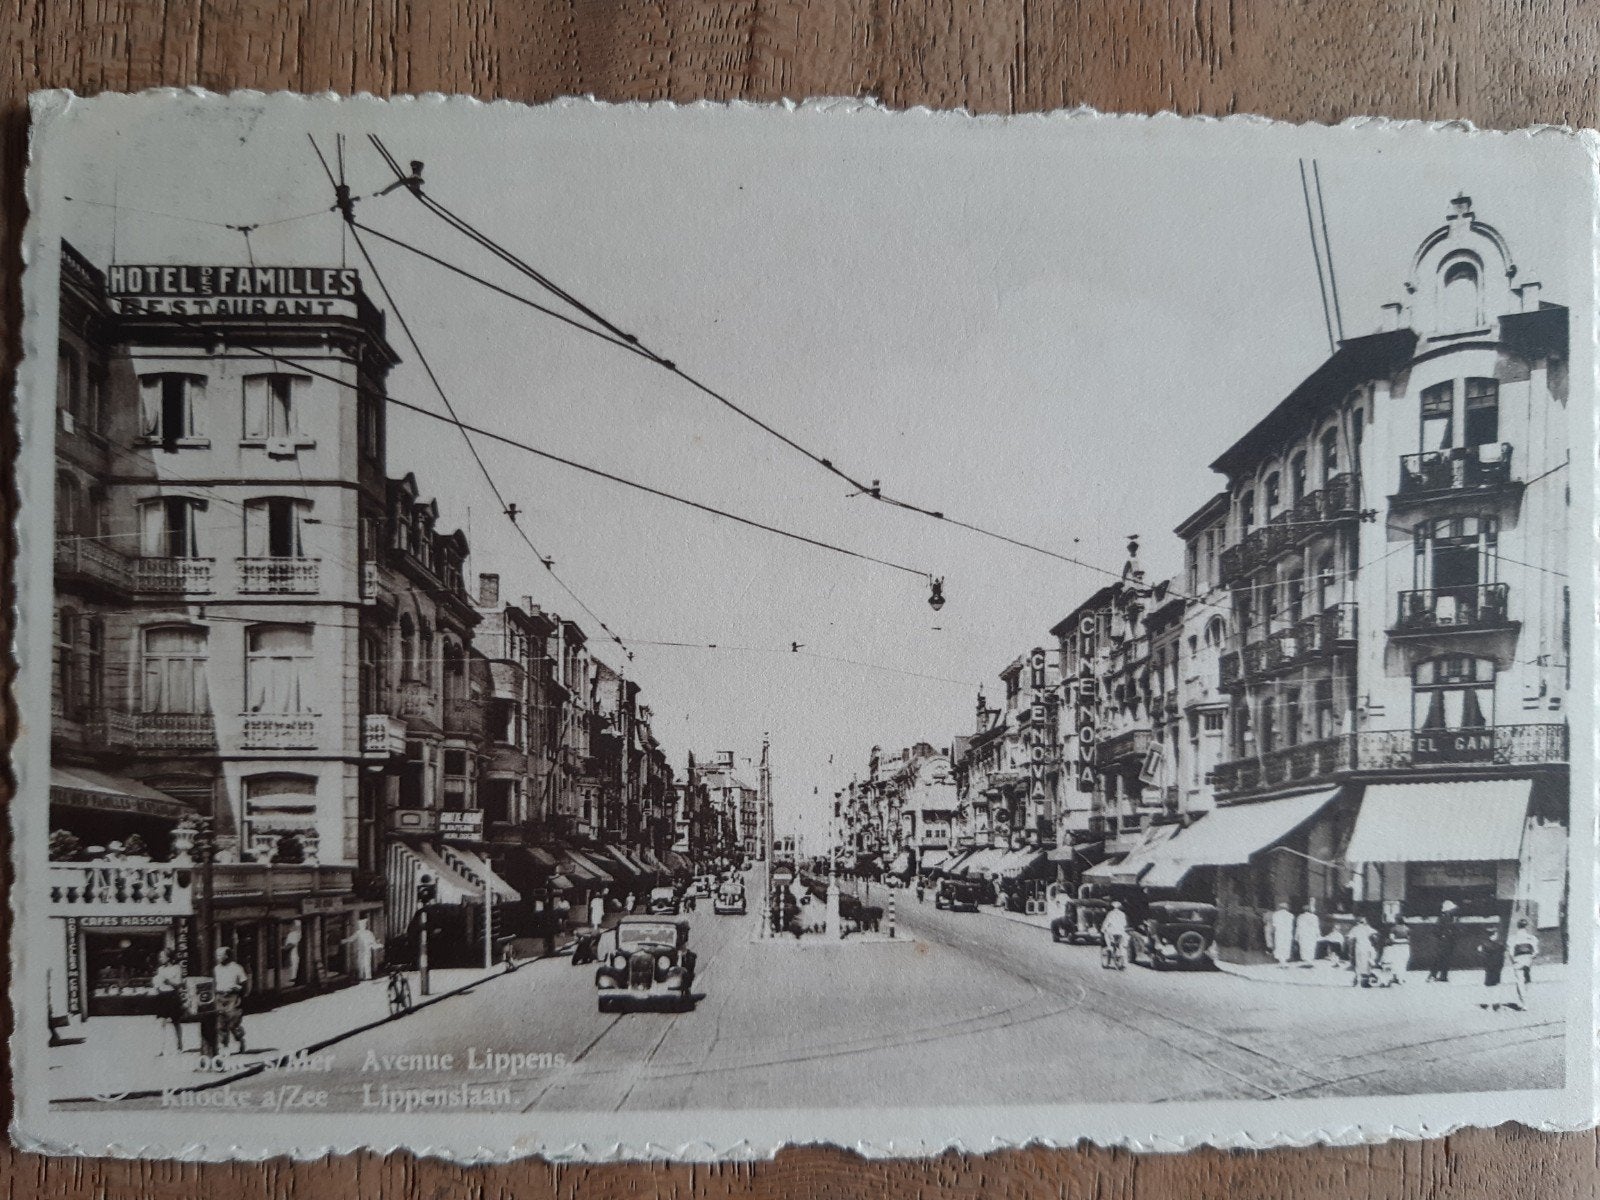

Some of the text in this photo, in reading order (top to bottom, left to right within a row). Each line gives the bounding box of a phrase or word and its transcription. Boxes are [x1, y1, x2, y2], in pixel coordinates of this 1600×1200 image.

[110, 266, 356, 295] HOTEL DES FAMILLES
[119, 297, 335, 316] RESTAURANT
